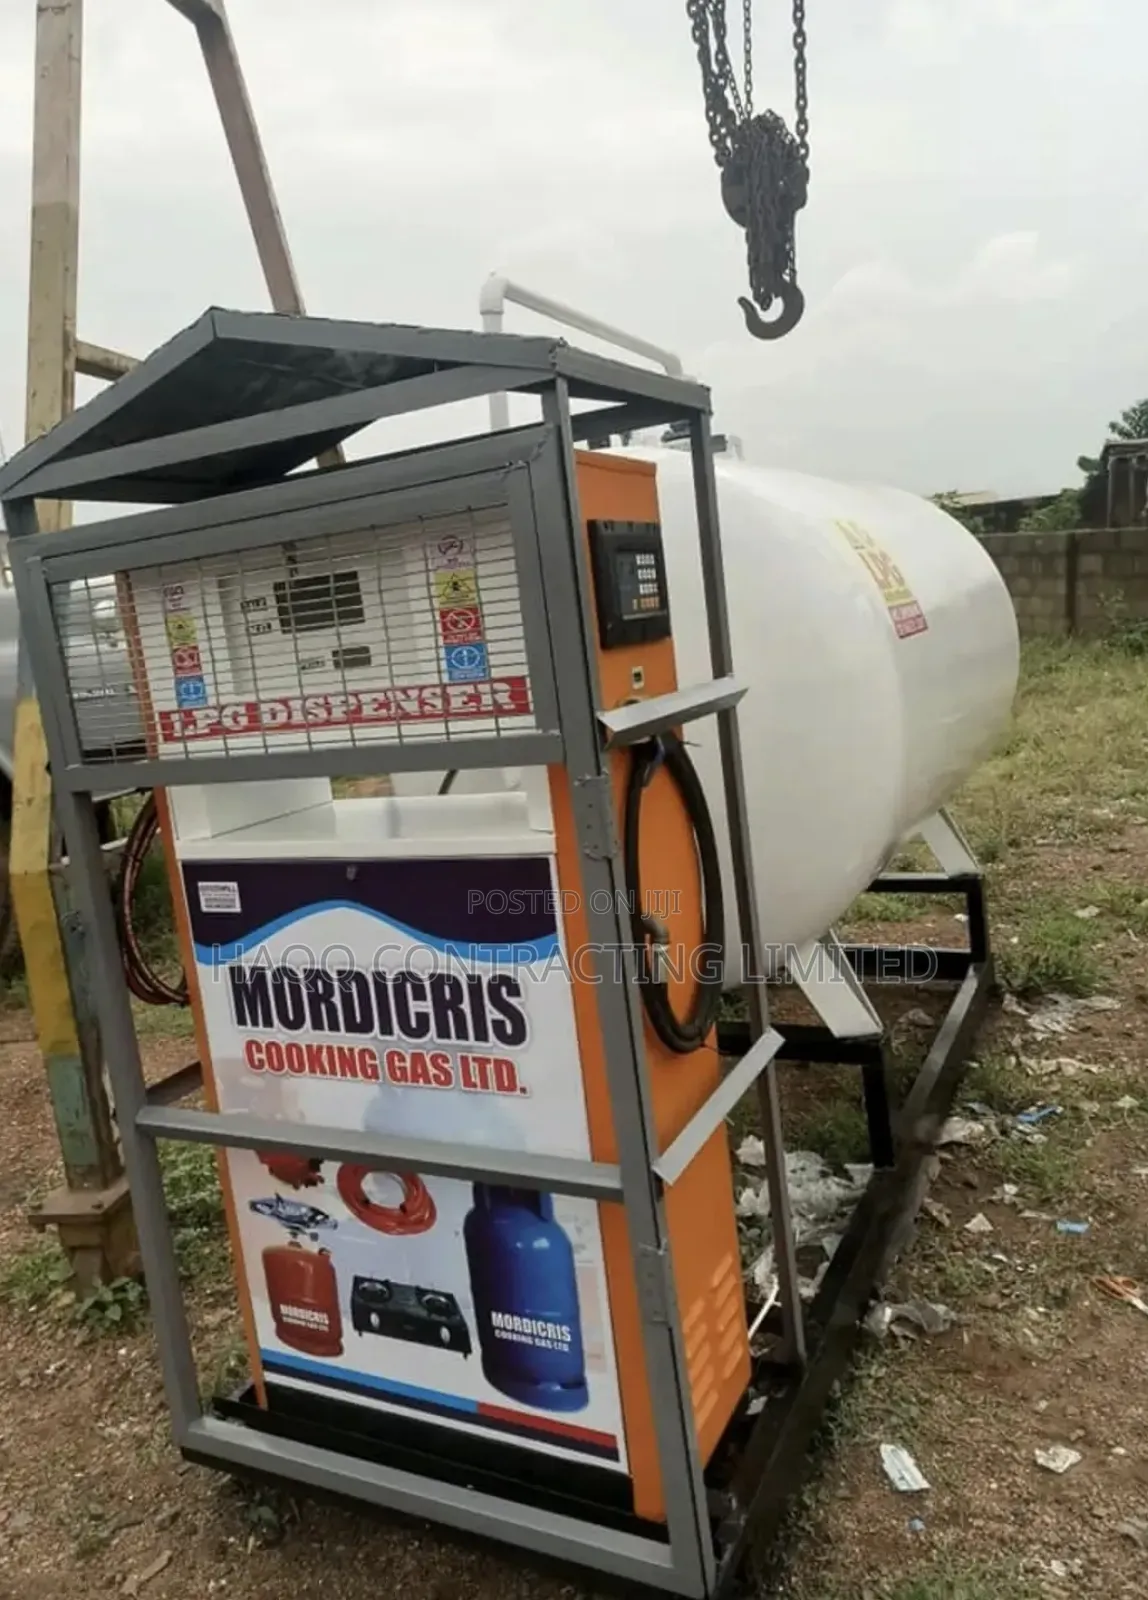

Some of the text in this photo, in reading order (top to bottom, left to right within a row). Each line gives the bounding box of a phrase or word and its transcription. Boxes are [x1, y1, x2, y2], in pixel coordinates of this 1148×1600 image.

[169, 682, 516, 738] LPG DISPENSER
[228, 964, 529, 1047] MORDICRIS
[245, 1039, 528, 1095] COOKING GAS LTD.
[491, 1311, 571, 1342] MORDICRIS
